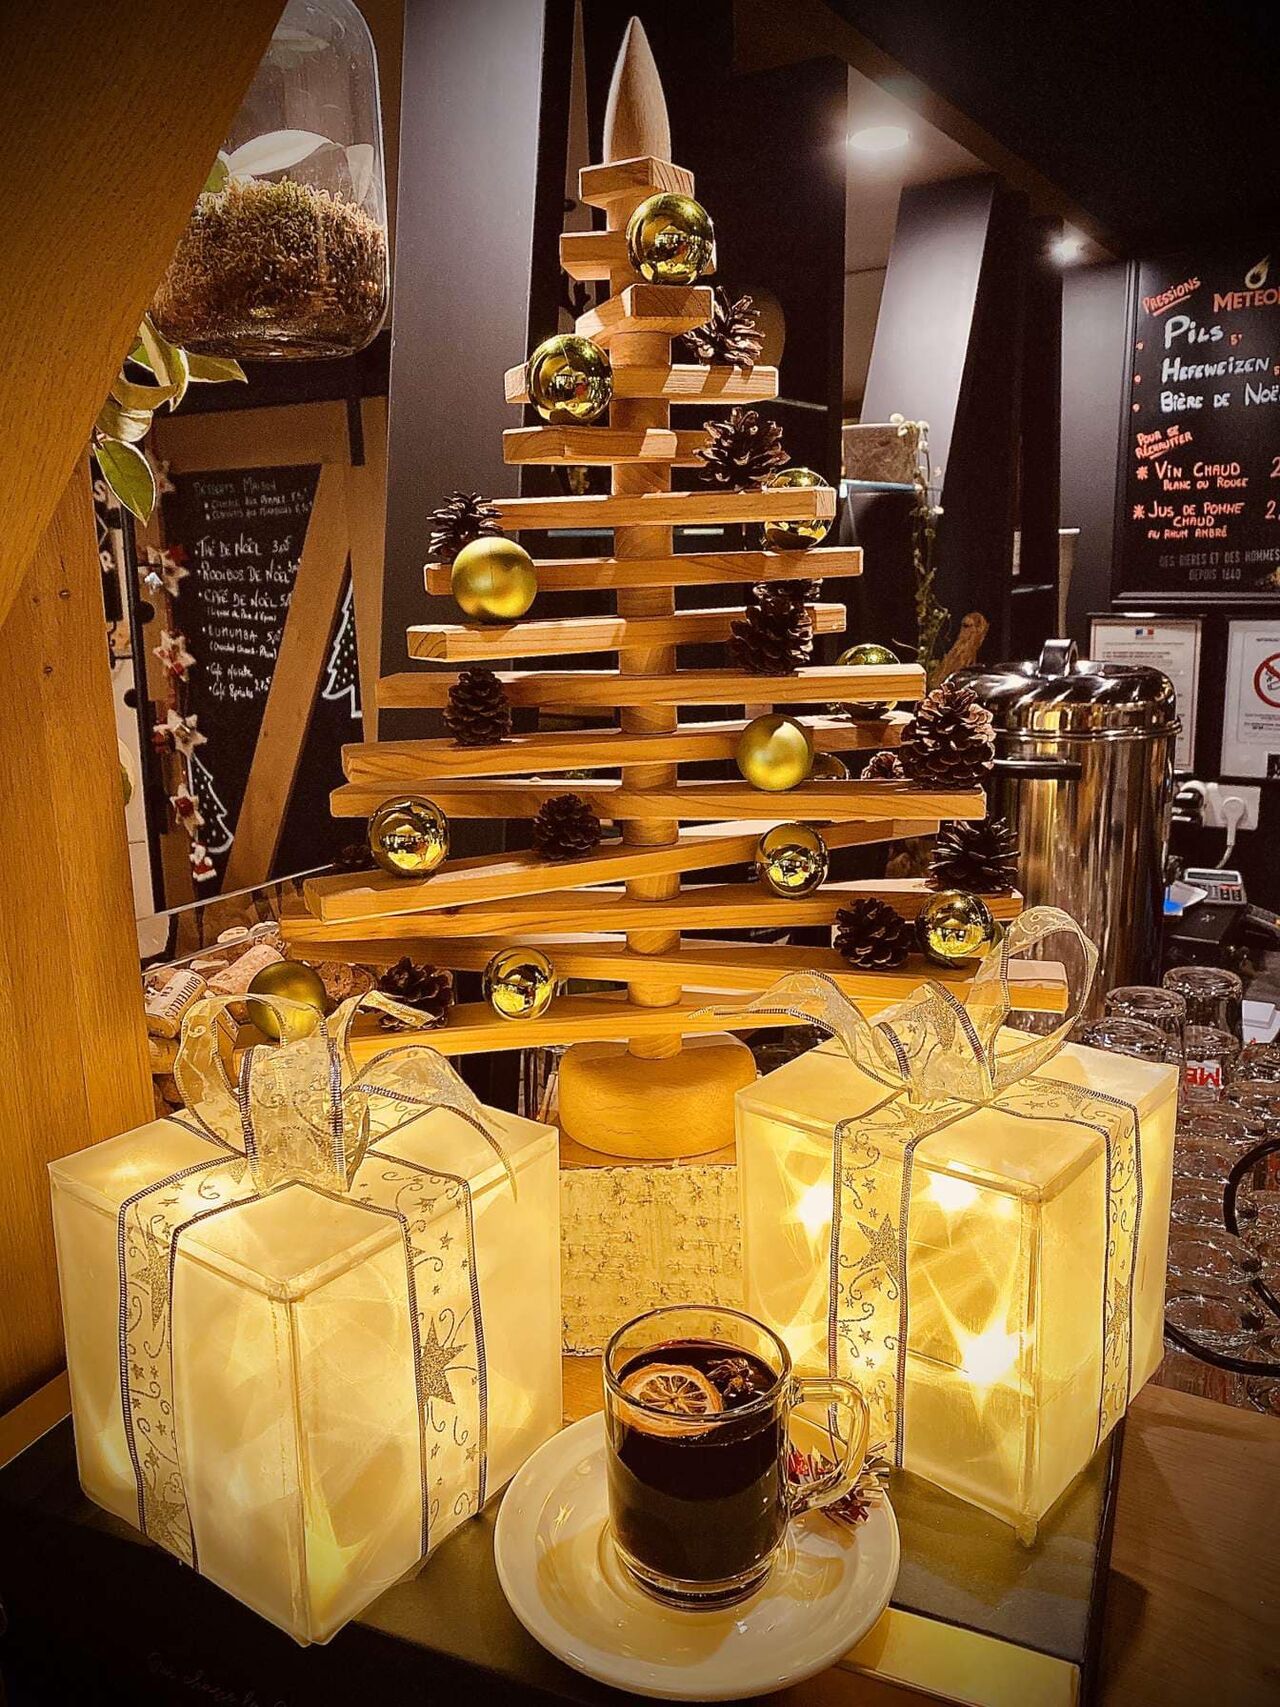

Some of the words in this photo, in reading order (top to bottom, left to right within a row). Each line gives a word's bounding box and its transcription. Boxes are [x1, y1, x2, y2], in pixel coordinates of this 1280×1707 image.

[1213, 288, 1280, 312] METEO
[1213, 392, 1231, 407] DE
[1245, 382, 1280, 406] NOË
[1155, 460, 1182, 479] VIN
[1193, 462, 1240, 476] CHAUD
[1163, 479, 1191, 491] BLANC
[1196, 481, 1209, 489] OU
[1217, 477, 1248, 488] ROUGE
[1148, 501, 1174, 518] JUS
[1183, 504, 1196, 515] DE
[1204, 502, 1245, 515] POMME
[1173, 515, 1215, 527] CHAUD
[247, 566, 261, 582] DE
